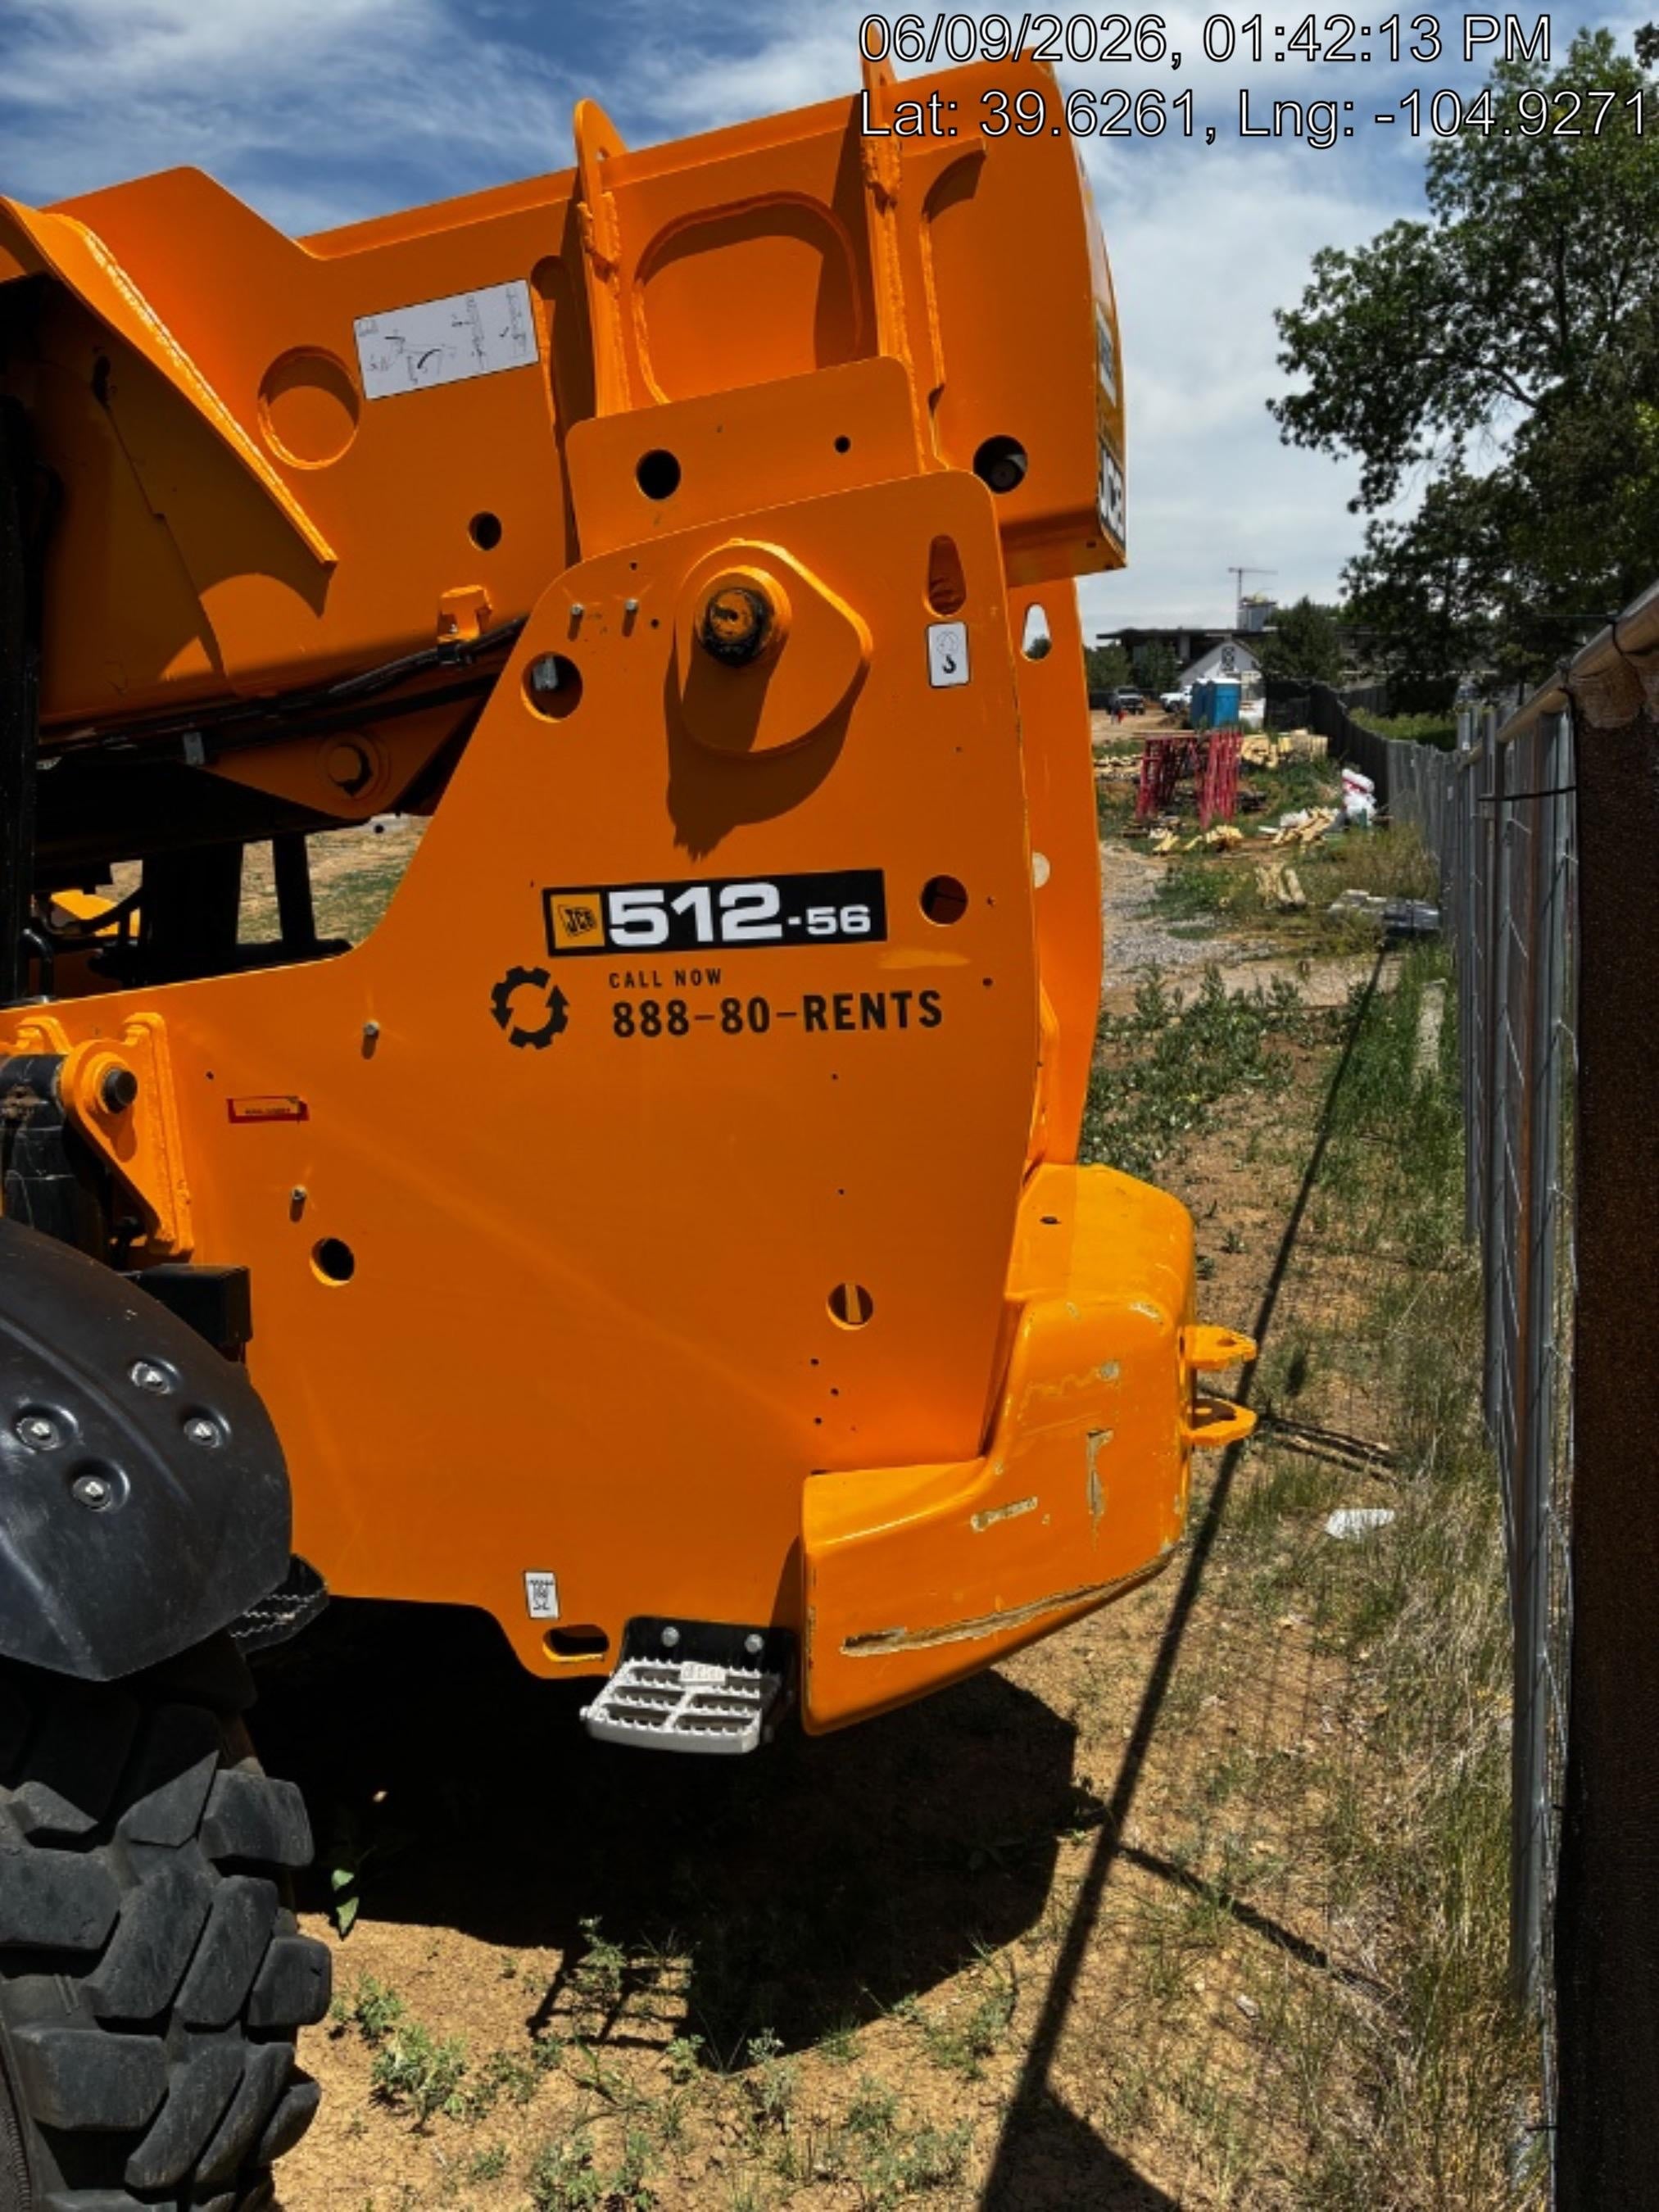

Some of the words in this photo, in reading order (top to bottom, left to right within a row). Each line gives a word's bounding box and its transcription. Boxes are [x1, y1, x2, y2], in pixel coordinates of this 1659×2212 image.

[608, 882, 871, 946] 512-56
[609, 972, 662, 989] CALL
[674, 968, 721, 986] NOW
[613, 990, 943, 1038] 888-80-RENTS
